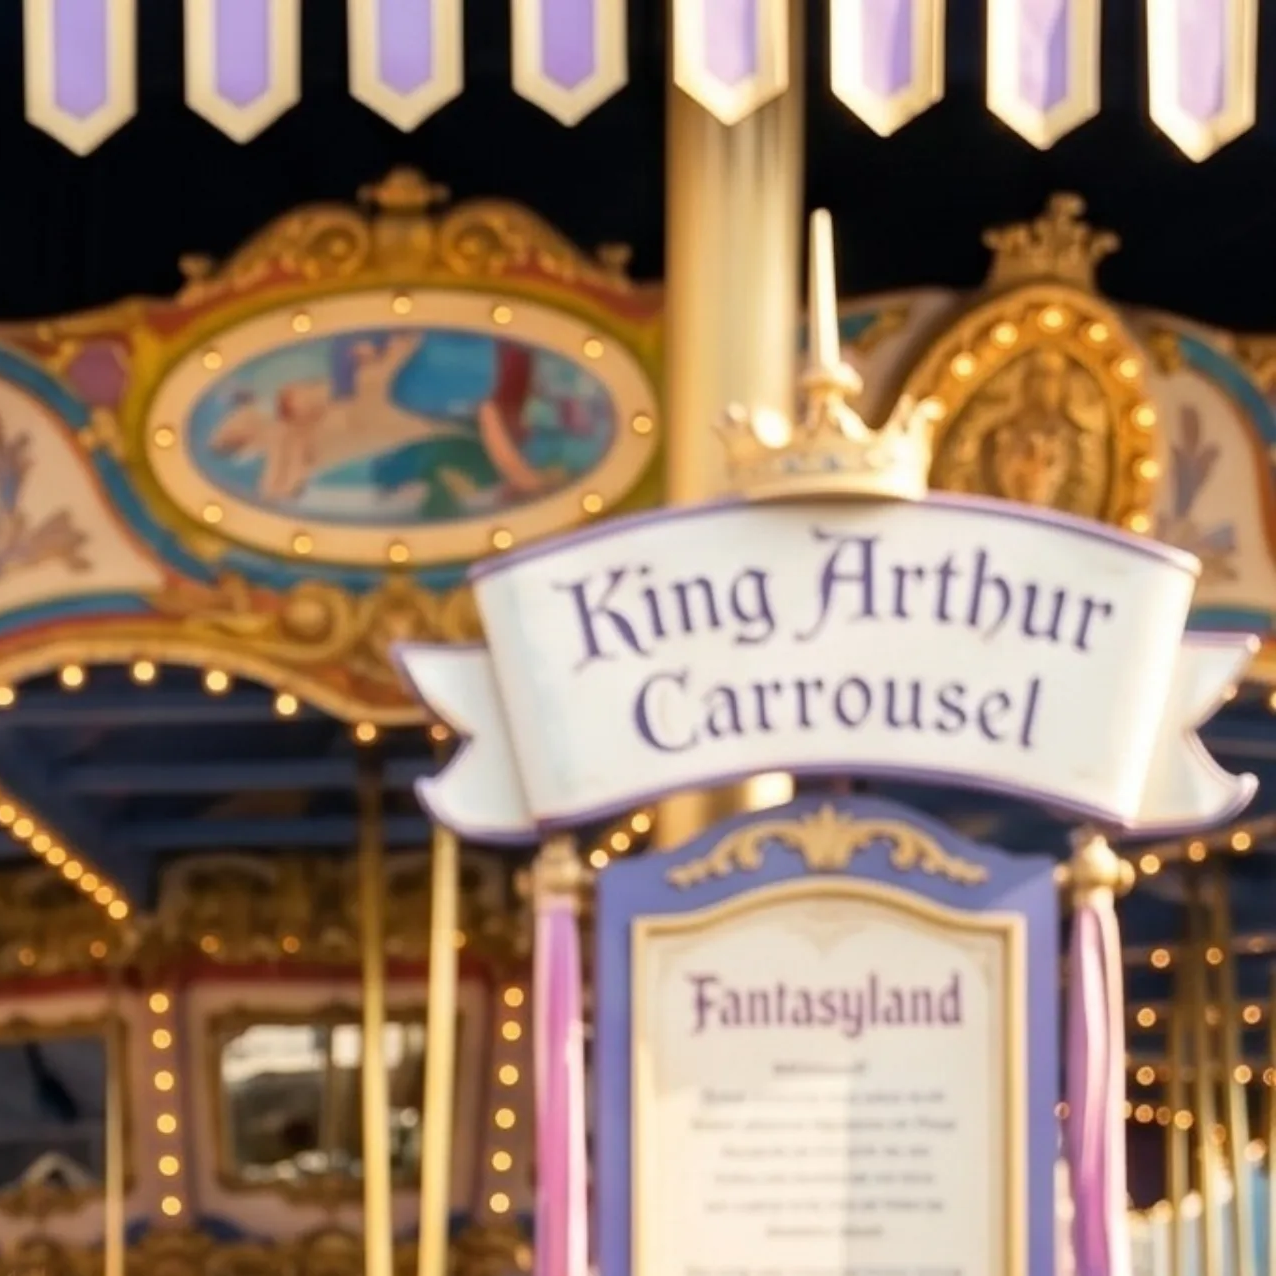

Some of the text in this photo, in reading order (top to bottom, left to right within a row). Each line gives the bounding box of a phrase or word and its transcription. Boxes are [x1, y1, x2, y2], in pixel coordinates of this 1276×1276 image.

[554, 527, 1113, 669] King Arthur
[633, 670, 1042, 753] Carrousel
[686, 973, 964, 1037] Fantasyland
